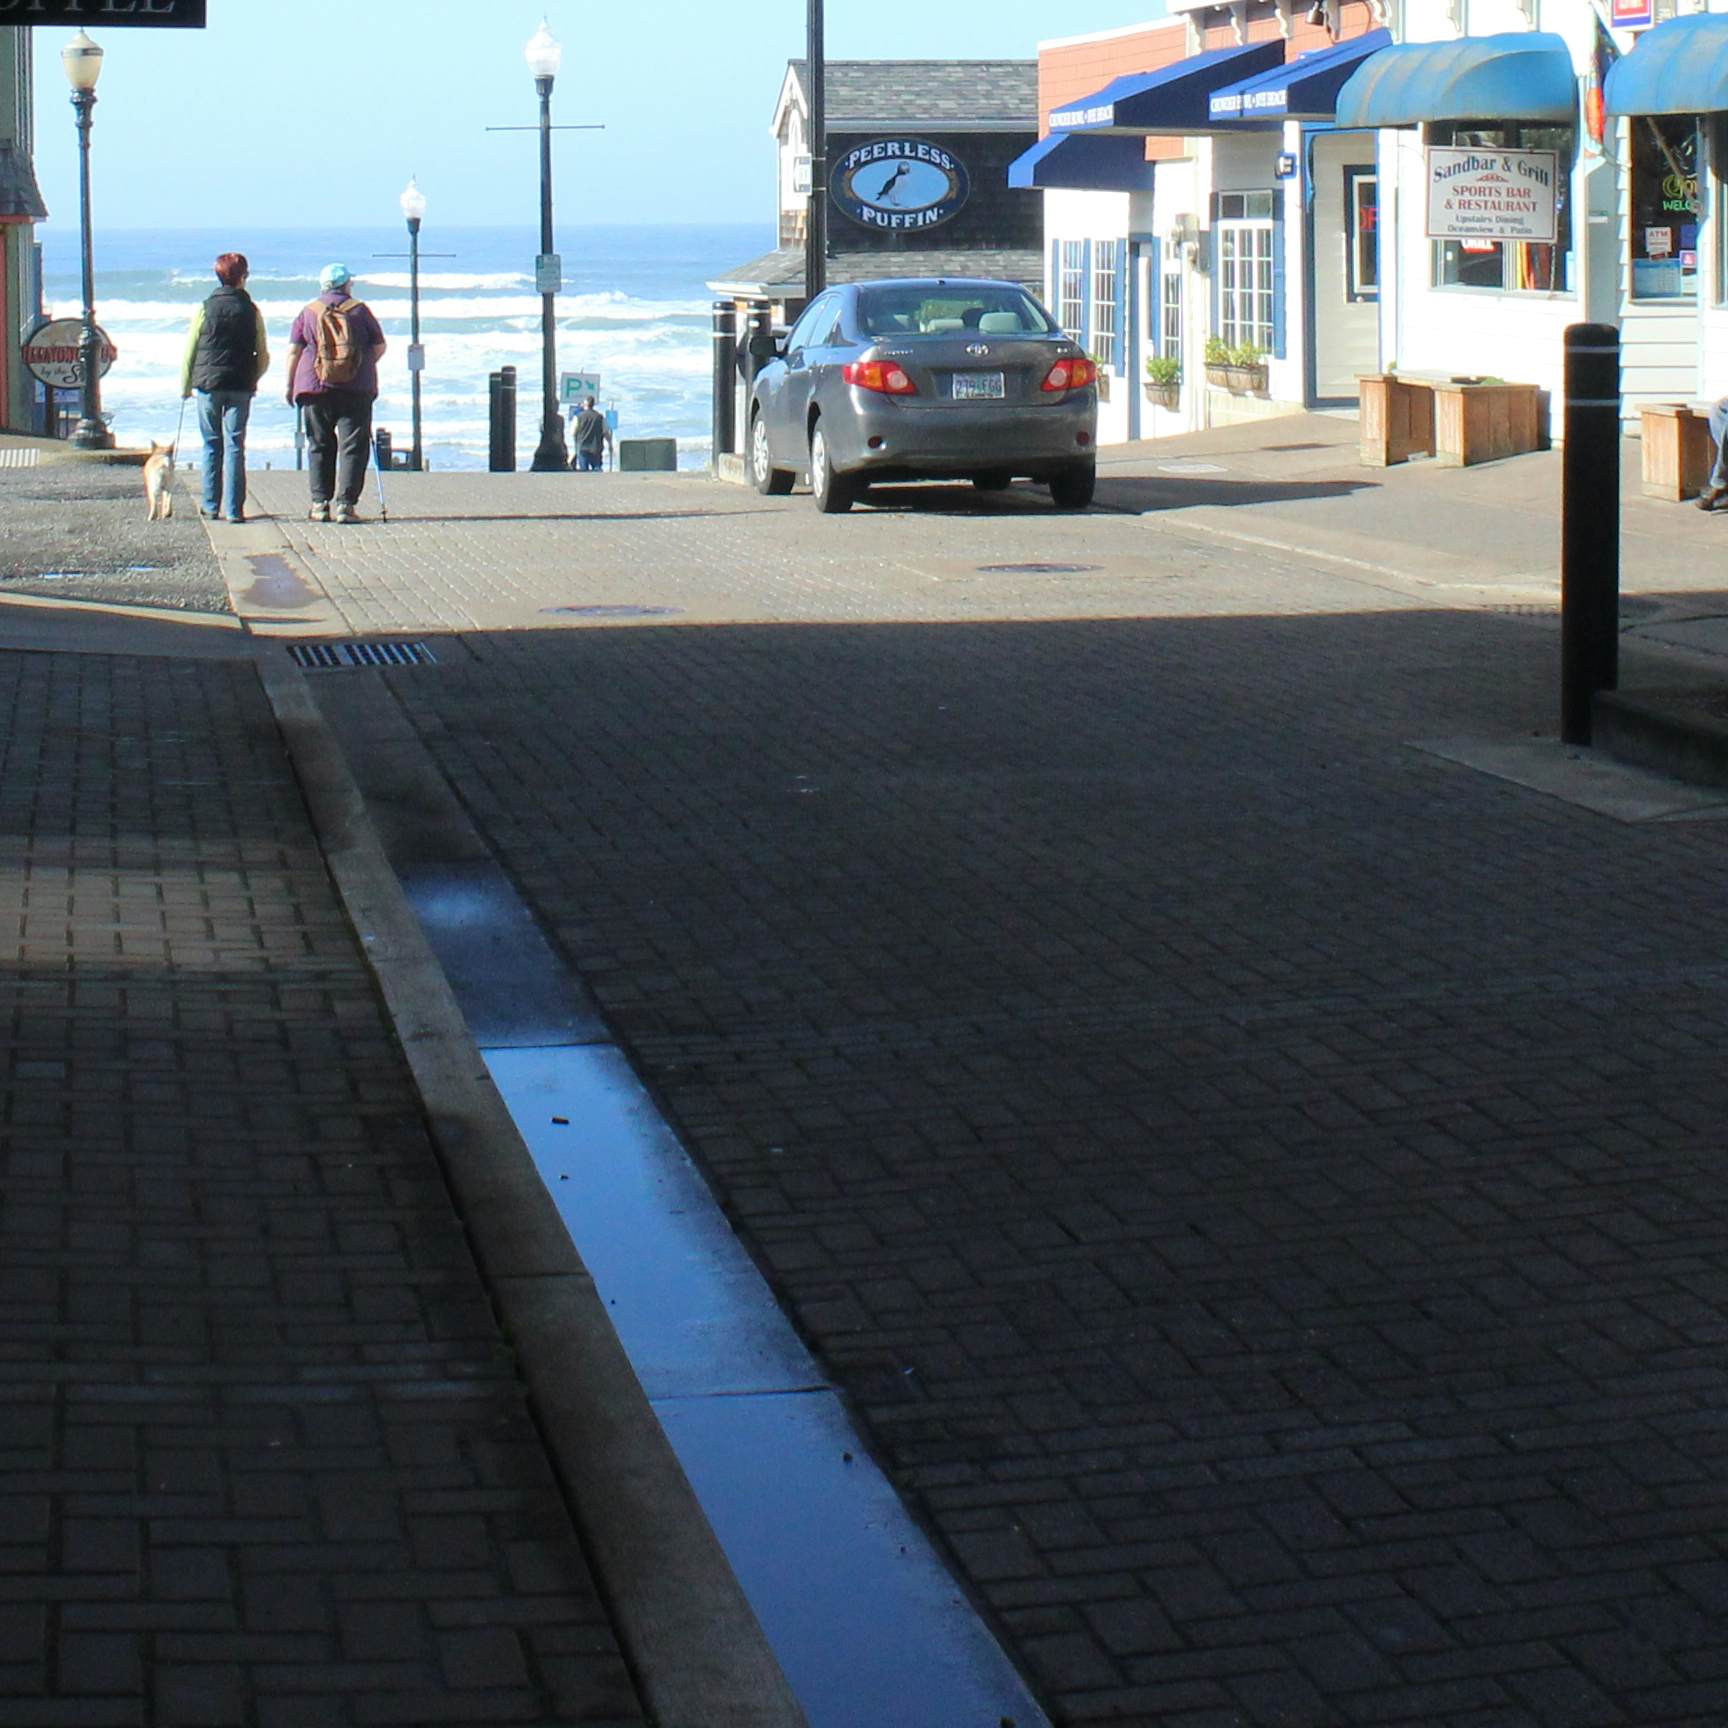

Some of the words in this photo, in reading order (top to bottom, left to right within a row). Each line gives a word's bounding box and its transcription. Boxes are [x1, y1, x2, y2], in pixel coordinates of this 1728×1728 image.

[848, 142, 952, 170] PEERLESS
[1433, 155, 1497, 183] Sandbar
[1501, 156, 1512, 172] &
[1518, 159, 1548, 187] Grill
[1452, 185, 1502, 198] SPORTS
[1507, 187, 1531, 198] BAR
[1444, 199, 1453, 210] &
[1458, 199, 1538, 212] RESTAURANT
[862, 205, 938, 228] PUFFIN
[1456, 214, 1492, 224] Upstairs
[1495, 215, 1524, 225] Dining
[1648, 230, 1668, 238] ATM
[567, 378, 582, 398] P
